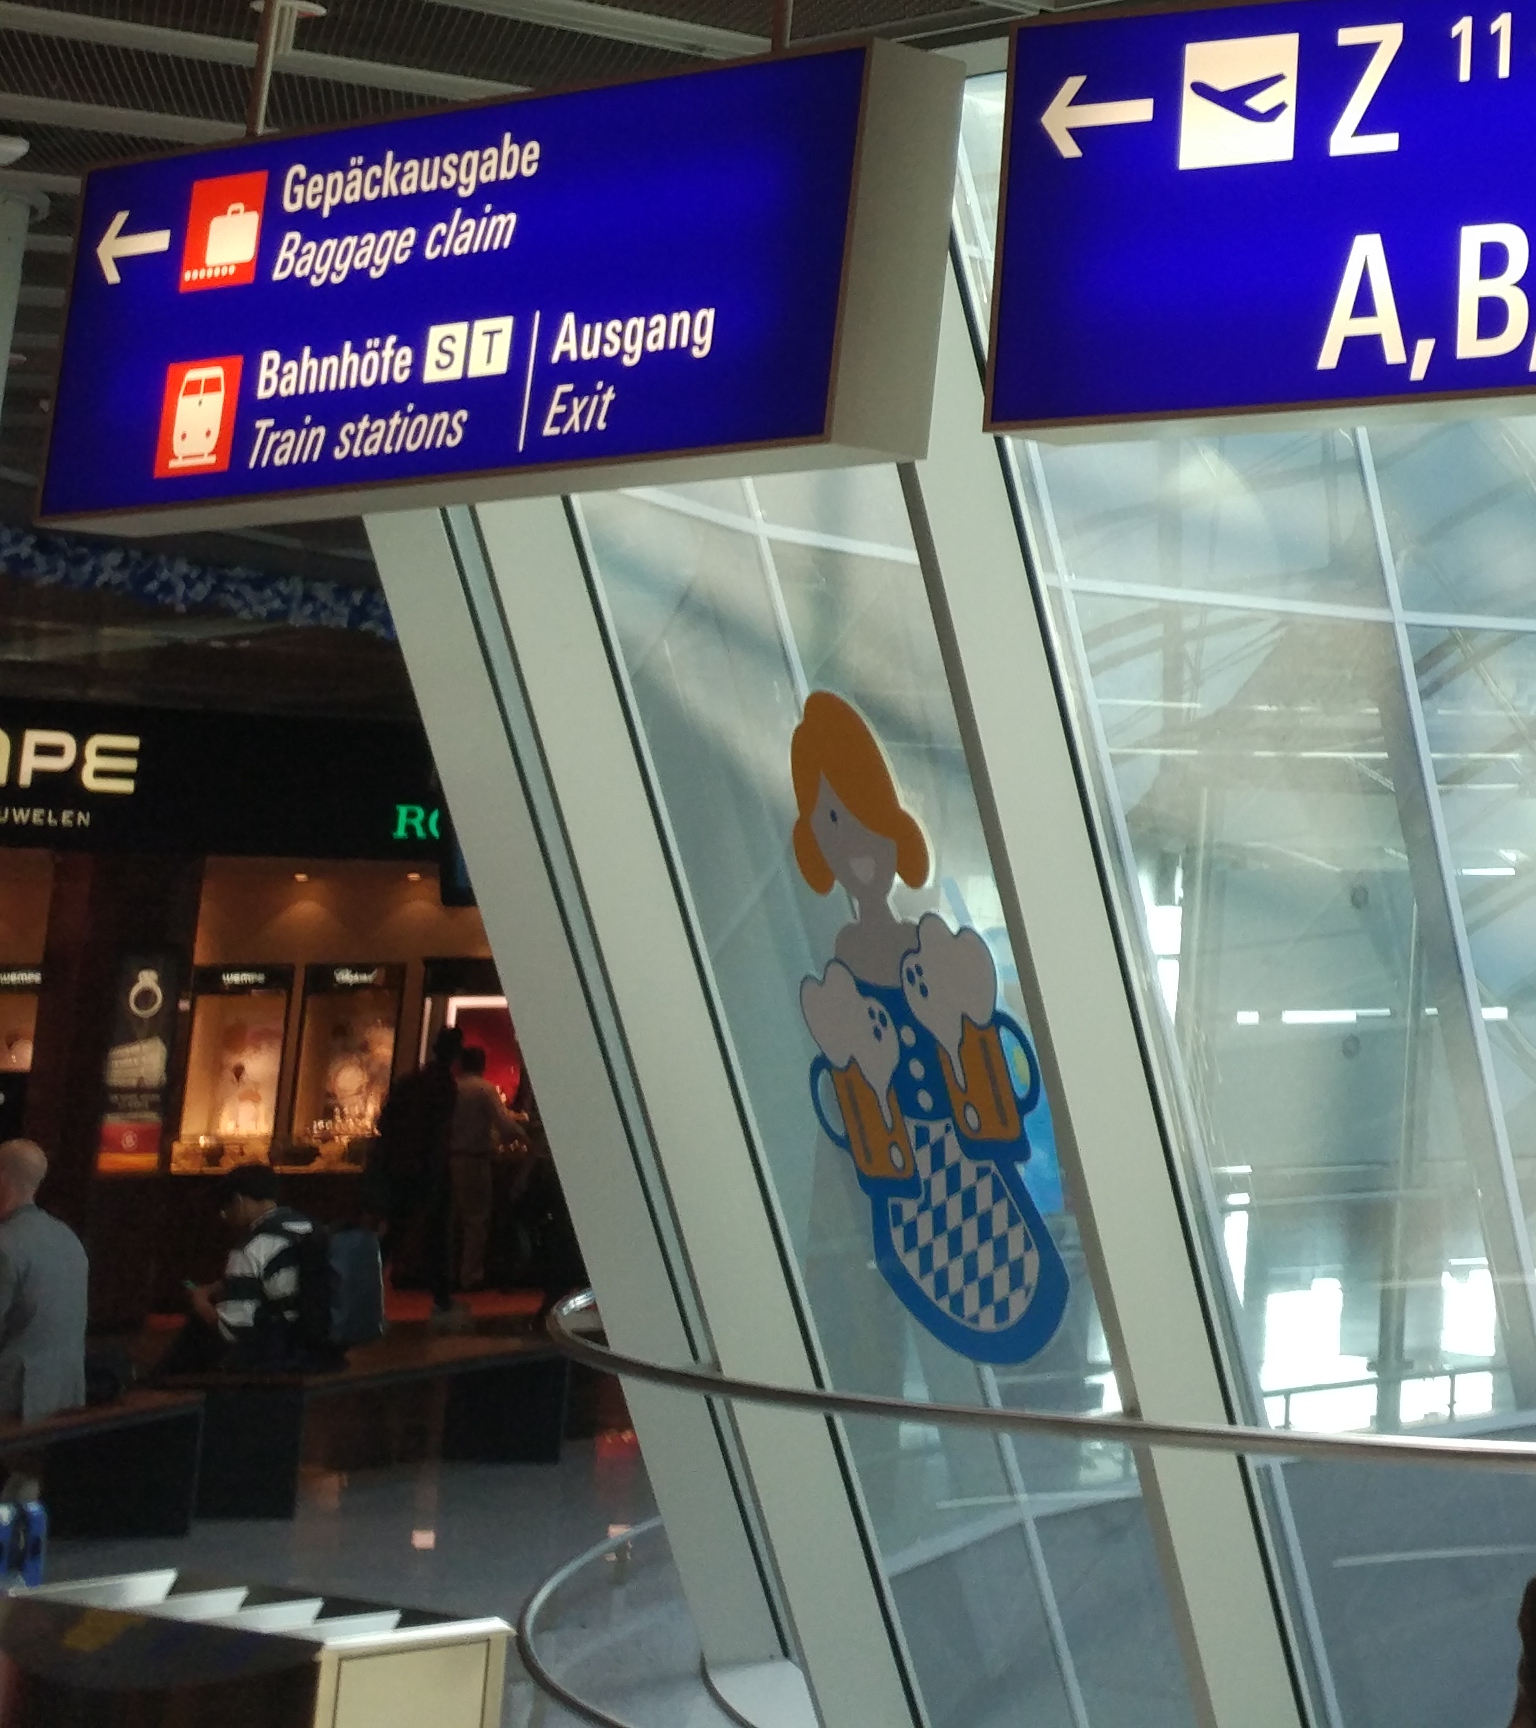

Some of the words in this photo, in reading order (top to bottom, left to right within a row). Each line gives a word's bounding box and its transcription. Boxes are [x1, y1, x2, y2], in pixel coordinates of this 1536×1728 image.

[1328, 22, 1404, 157] Z
[1451, 12, 1512, 83] 11
[282, 132, 541, 216] Gepäckausgabe
[271, 226, 417, 288] Baggage
[424, 203, 517, 260] claim
[256, 339, 413, 400] Bahnhöfe
[551, 307, 716, 367] Ausgang
[248, 414, 326, 469] Train
[333, 402, 469, 460] stations
[542, 380, 616, 437] Exit
[0, 728, 141, 796] PE
